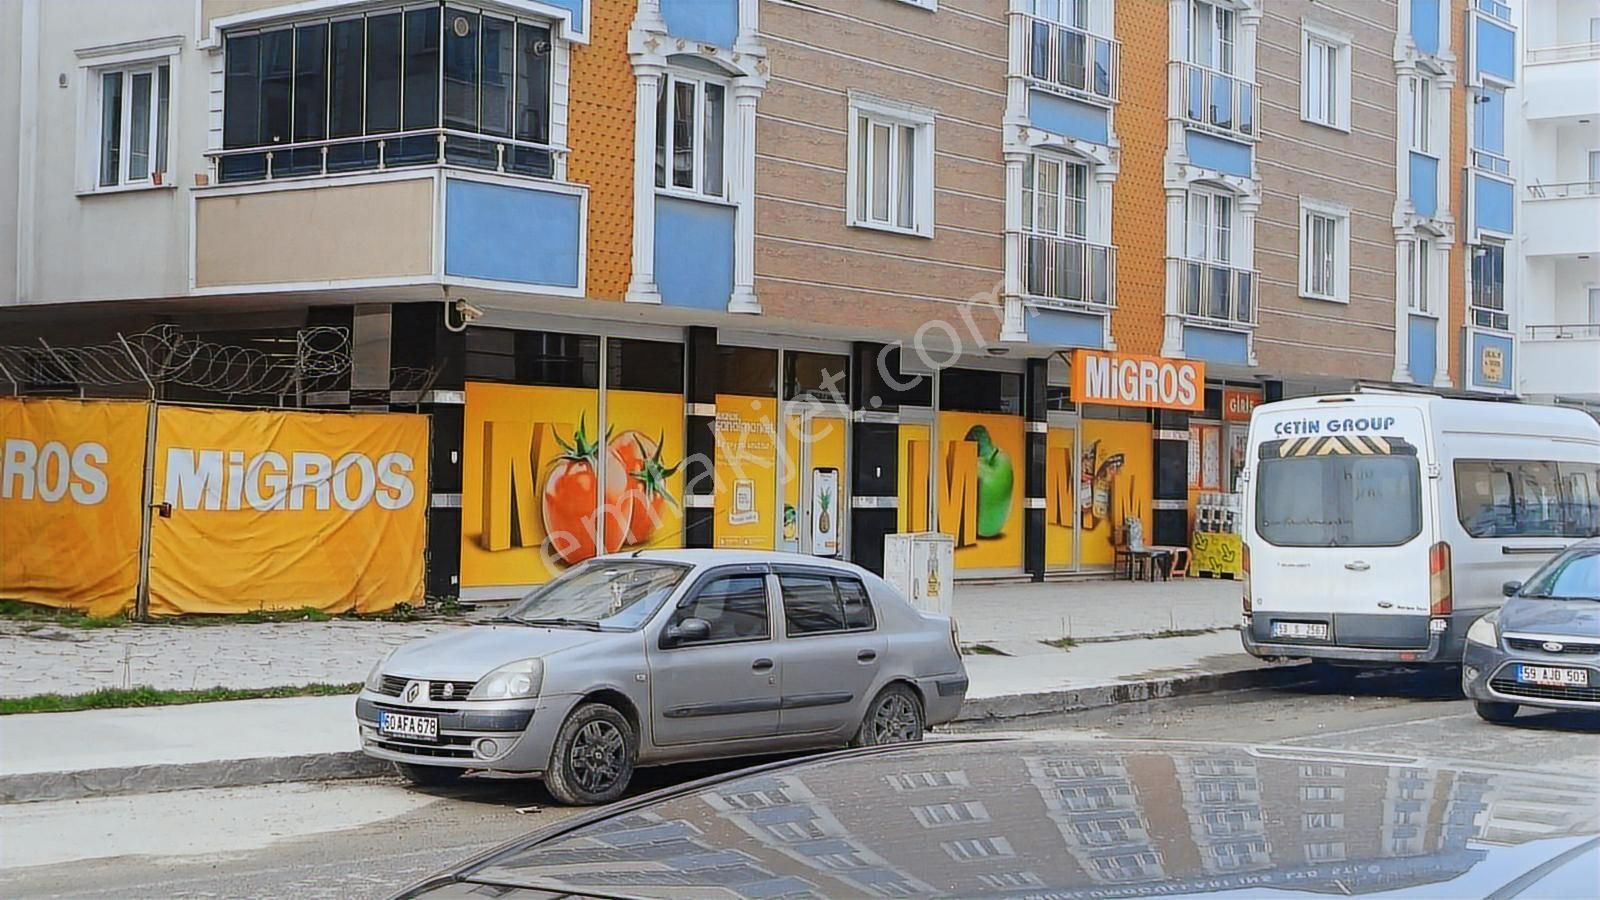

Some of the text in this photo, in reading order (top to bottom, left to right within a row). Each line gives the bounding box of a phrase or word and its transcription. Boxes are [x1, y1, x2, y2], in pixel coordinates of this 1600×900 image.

[1274, 416, 1396, 438] ÇETİN GROUP
[0, 438, 108, 505] ROS
[1523, 667, 1536, 679] 59
[1566, 670, 1586, 682] 503
[397, 715, 415, 733] AFA
[417, 717, 436, 735] 678
